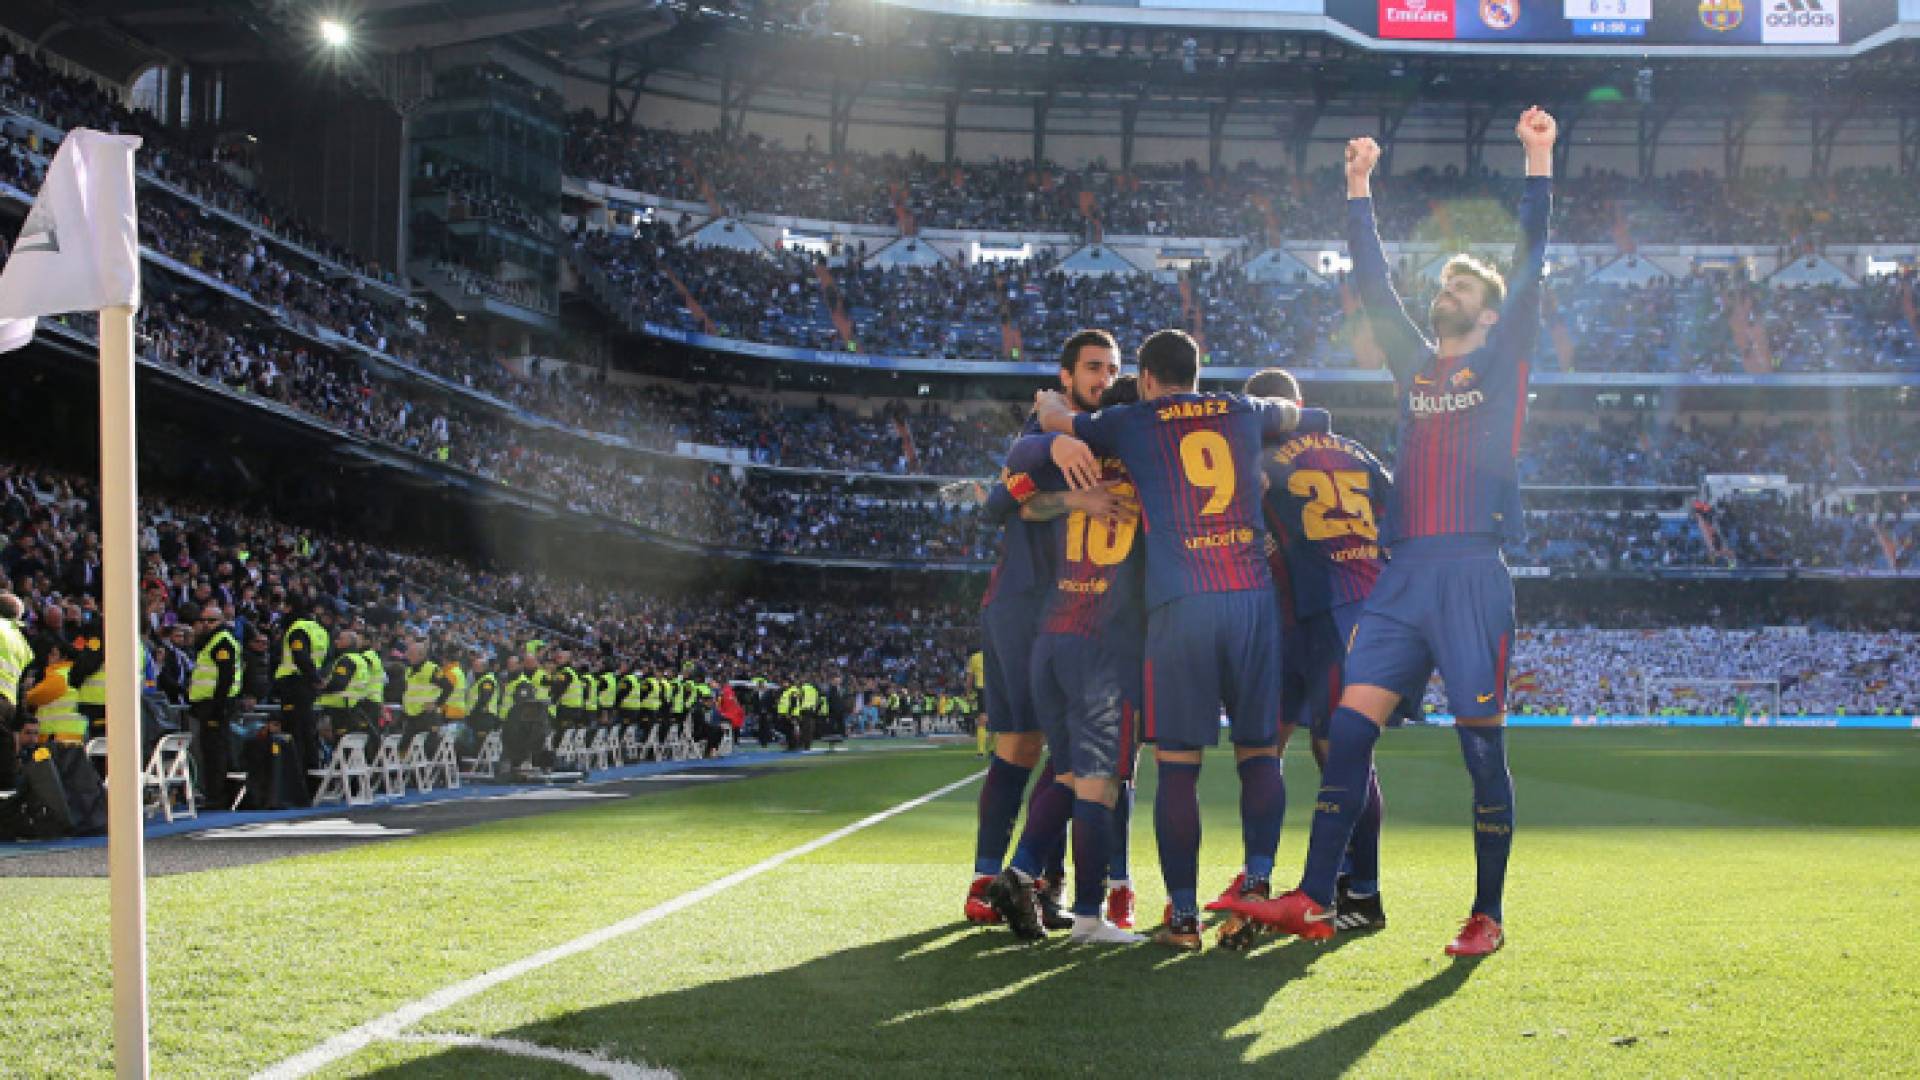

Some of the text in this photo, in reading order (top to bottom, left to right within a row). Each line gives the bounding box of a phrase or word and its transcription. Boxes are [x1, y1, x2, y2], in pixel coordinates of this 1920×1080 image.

[1386, 7, 1448, 23] Emirates
[1765, 9, 1834, 27] adidas
[1180, 430, 1236, 515] 9
[1287, 469, 1378, 541] 25
[1067, 482, 1141, 566] 10
